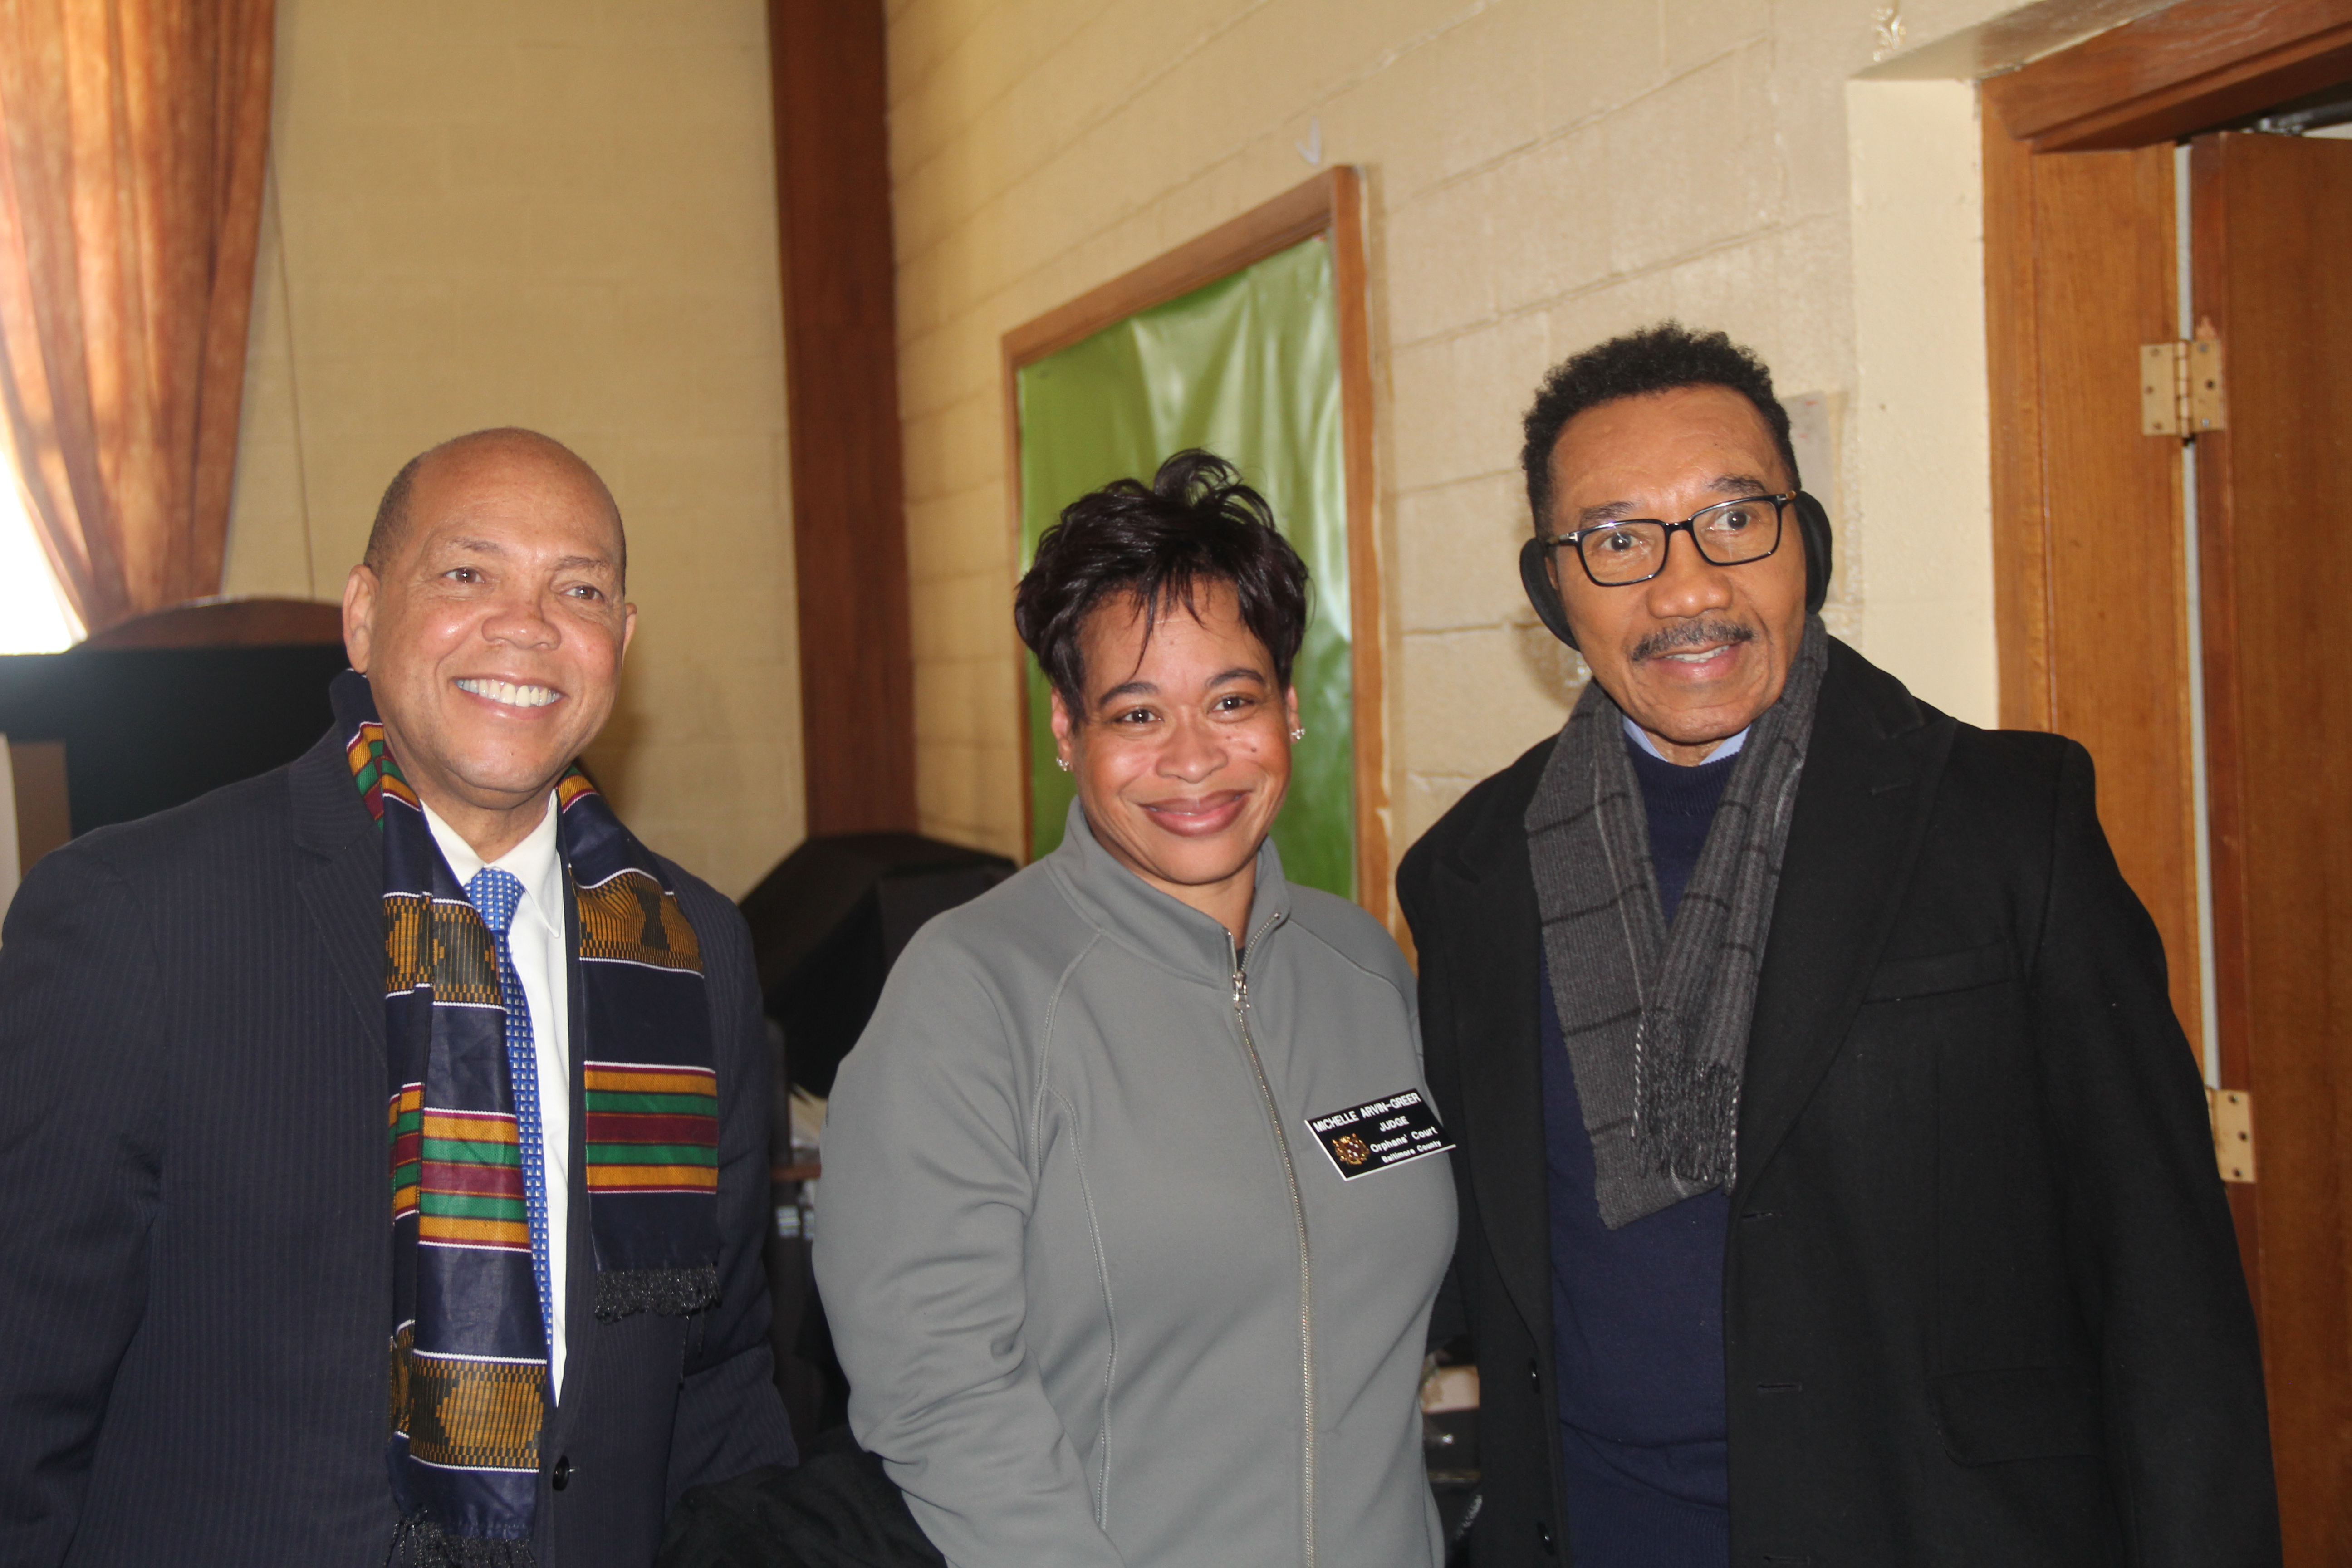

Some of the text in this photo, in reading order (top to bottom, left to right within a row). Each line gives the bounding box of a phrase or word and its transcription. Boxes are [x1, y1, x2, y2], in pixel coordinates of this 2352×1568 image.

[1313, 1092, 1422, 1132] MICHELLE ARVIN-GREER
[1379, 1116, 1410, 1132] JUDGE
[1411, 1126, 1438, 1140] Court
[1381, 1140, 1442, 1163] Baltimore County
